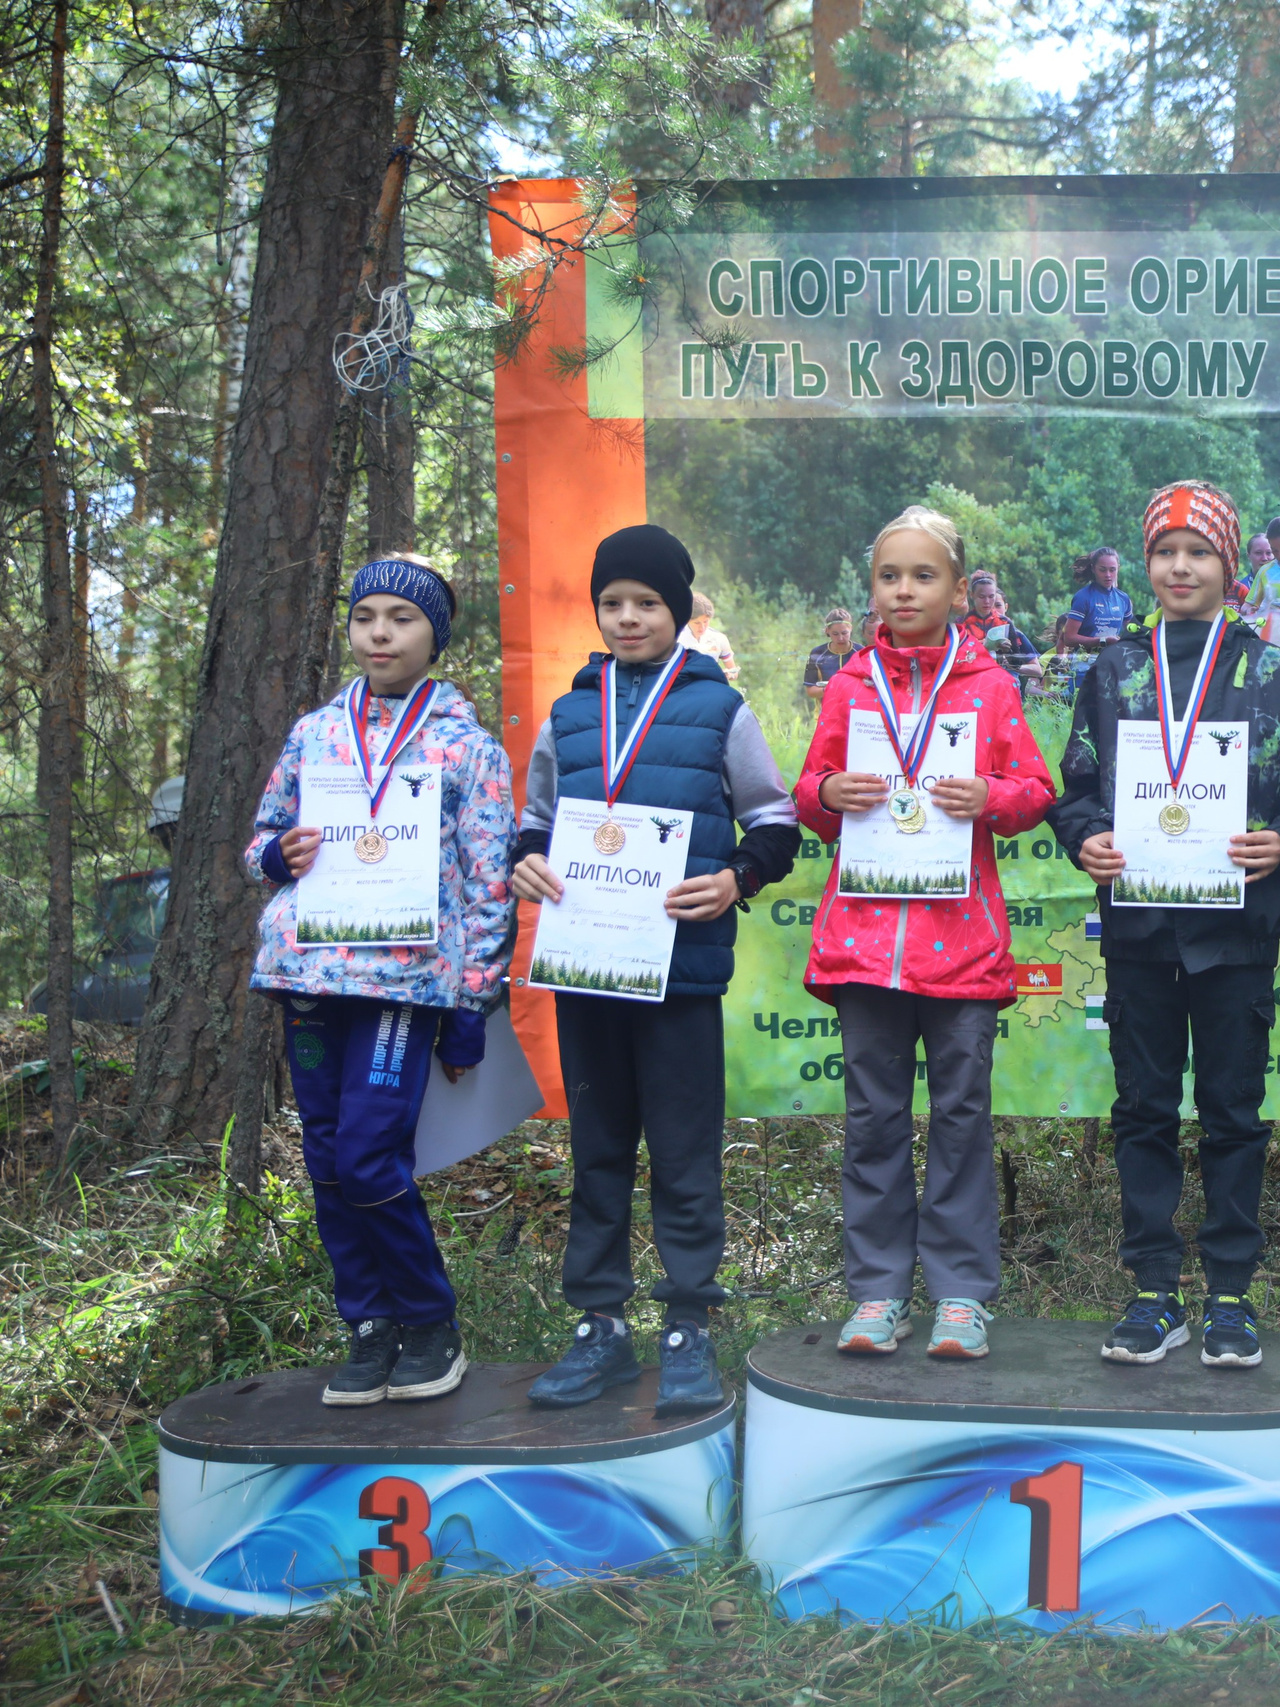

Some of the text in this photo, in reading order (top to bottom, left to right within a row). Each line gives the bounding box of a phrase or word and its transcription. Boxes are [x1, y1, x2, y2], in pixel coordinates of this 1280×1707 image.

[708, 257, 1107, 318] СПОРТИВНОЕ
[680, 341, 829, 399] ПУТЬ
[848, 340, 883, 399] К
[899, 339, 1268, 408] ЗДОРОВОМУ
[1134, 782, 1226, 800] ДИПЛОМ
[565, 861, 662, 889] ДИПЛОМ
[372, 1009, 395, 1070] СПОРТИВНОЕ
[390, 1002, 415, 1072] ОРИЕНТИРОВА
[368, 1070, 400, 1088] ЮГРА
[359, 1476, 433, 1596] 3
[1010, 1460, 1084, 1612] 1
